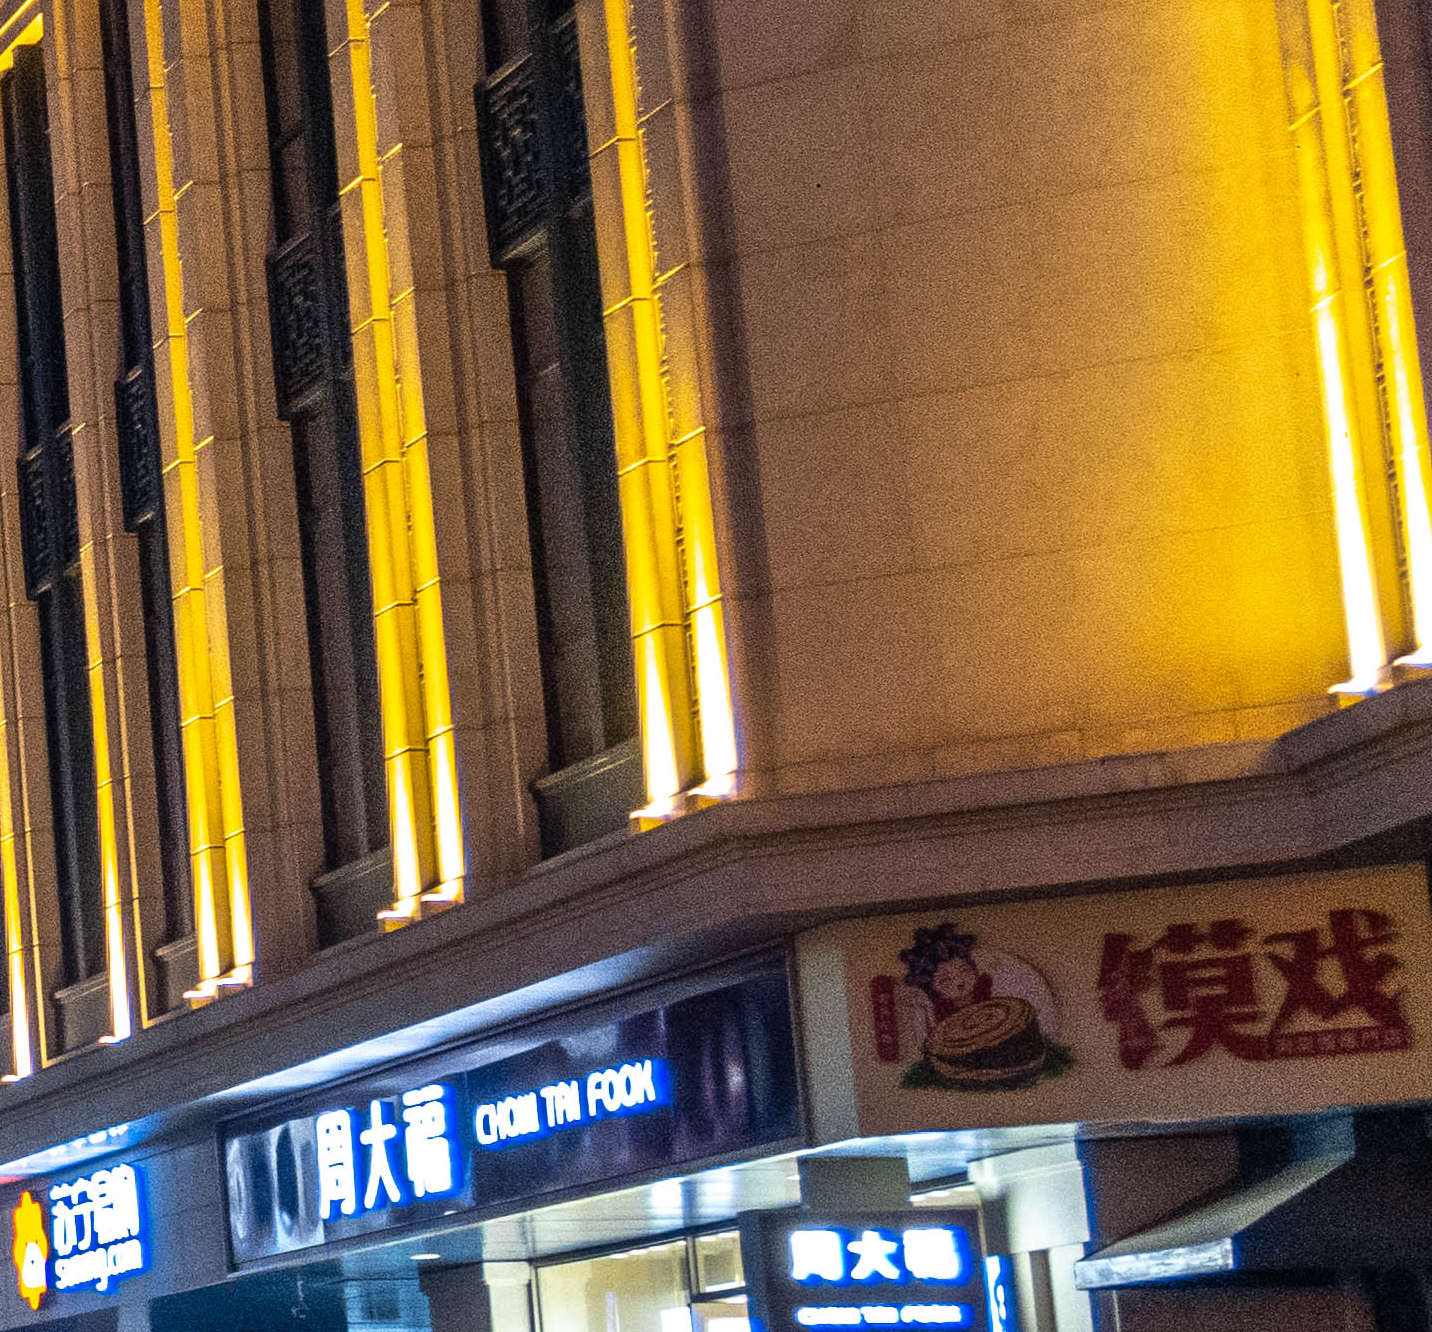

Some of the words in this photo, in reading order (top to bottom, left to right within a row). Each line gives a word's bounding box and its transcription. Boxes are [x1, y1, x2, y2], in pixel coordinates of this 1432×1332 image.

[1098, 908, 1413, 1068] 馍戏
[316, 1084, 452, 1219] 周大福
[587, 1059, 656, 1116] FOOK
